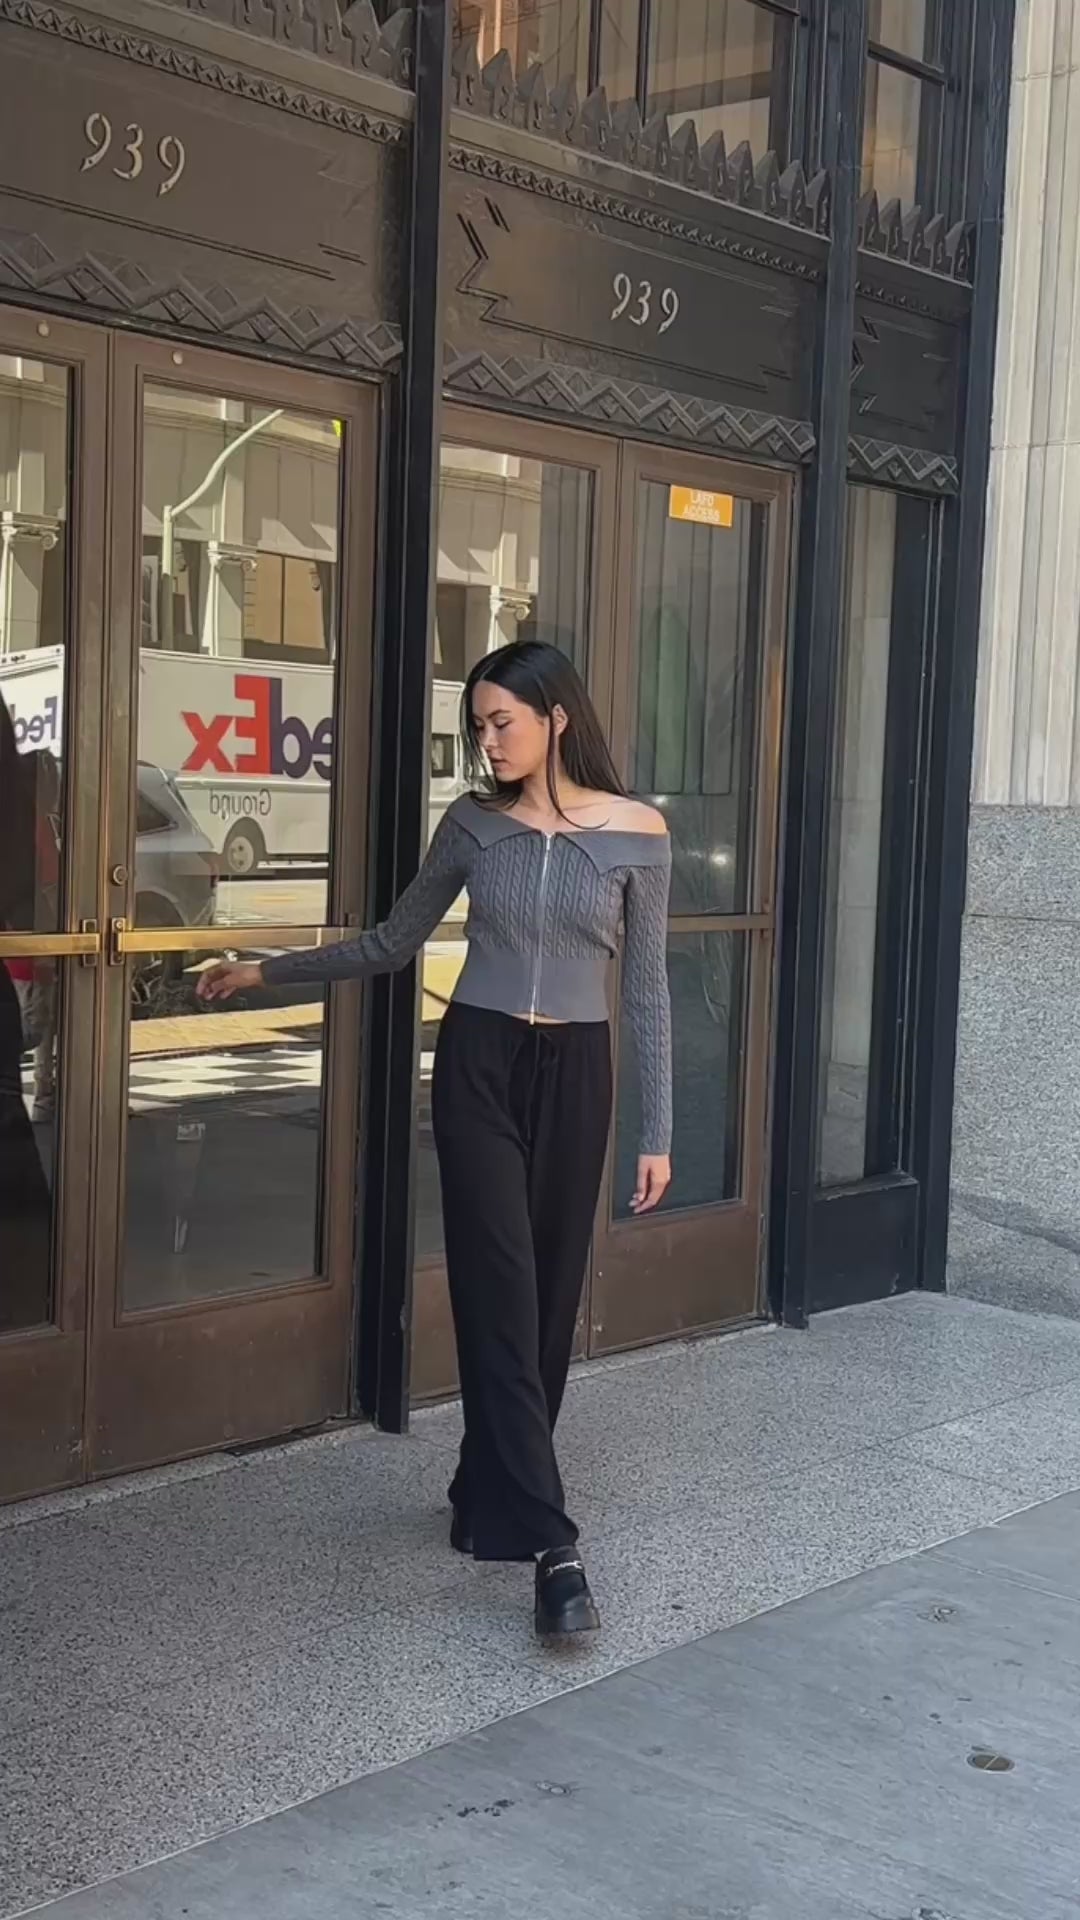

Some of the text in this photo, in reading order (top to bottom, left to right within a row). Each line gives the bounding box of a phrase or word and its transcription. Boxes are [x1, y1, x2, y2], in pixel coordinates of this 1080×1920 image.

[80, 112, 186, 197] 939
[610, 272, 680, 335] 939
[681, 503, 721, 522] ACCESS
